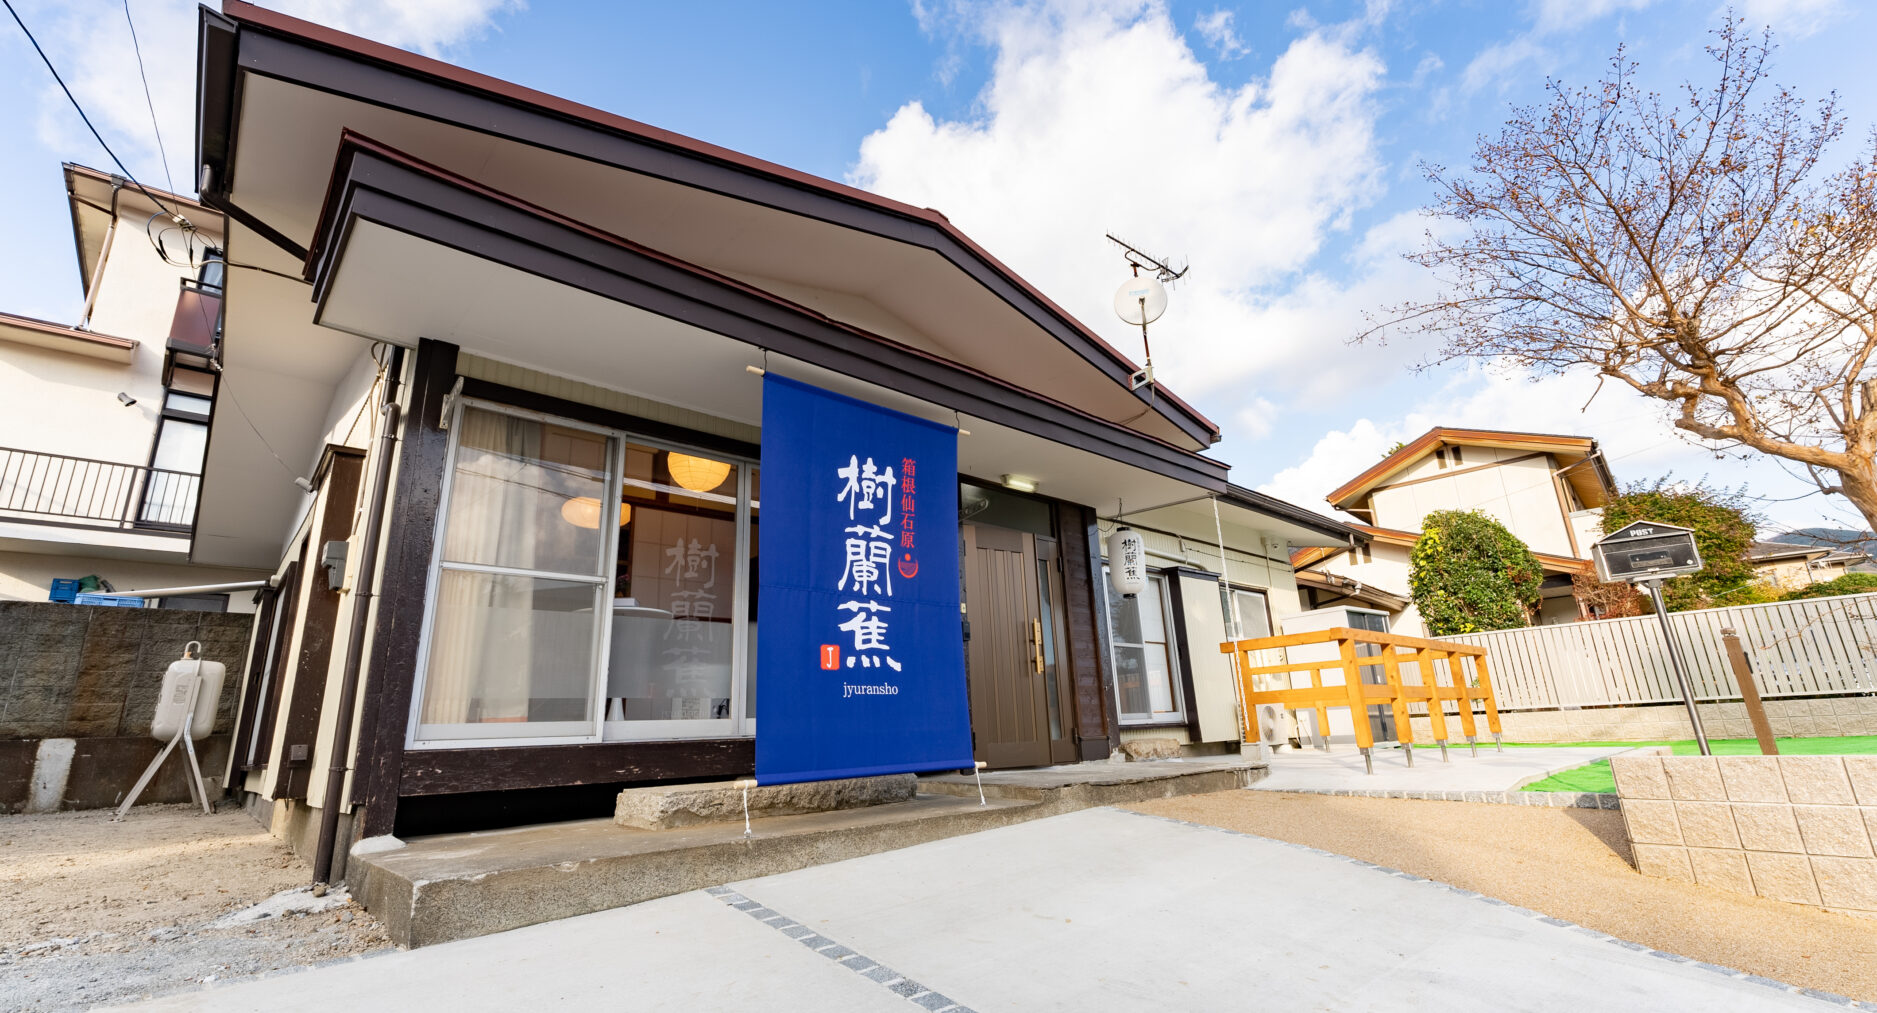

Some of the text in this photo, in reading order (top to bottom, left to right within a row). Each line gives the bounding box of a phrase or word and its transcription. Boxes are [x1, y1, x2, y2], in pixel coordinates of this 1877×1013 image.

[901, 457, 916, 549] 箱根仙石原
[1629, 527, 1654, 537] POST
[837, 454, 901, 672] 樹蘭蕉
[662, 537, 719, 698] 樹蘭蕉
[843, 682, 899, 698] jyuransho
